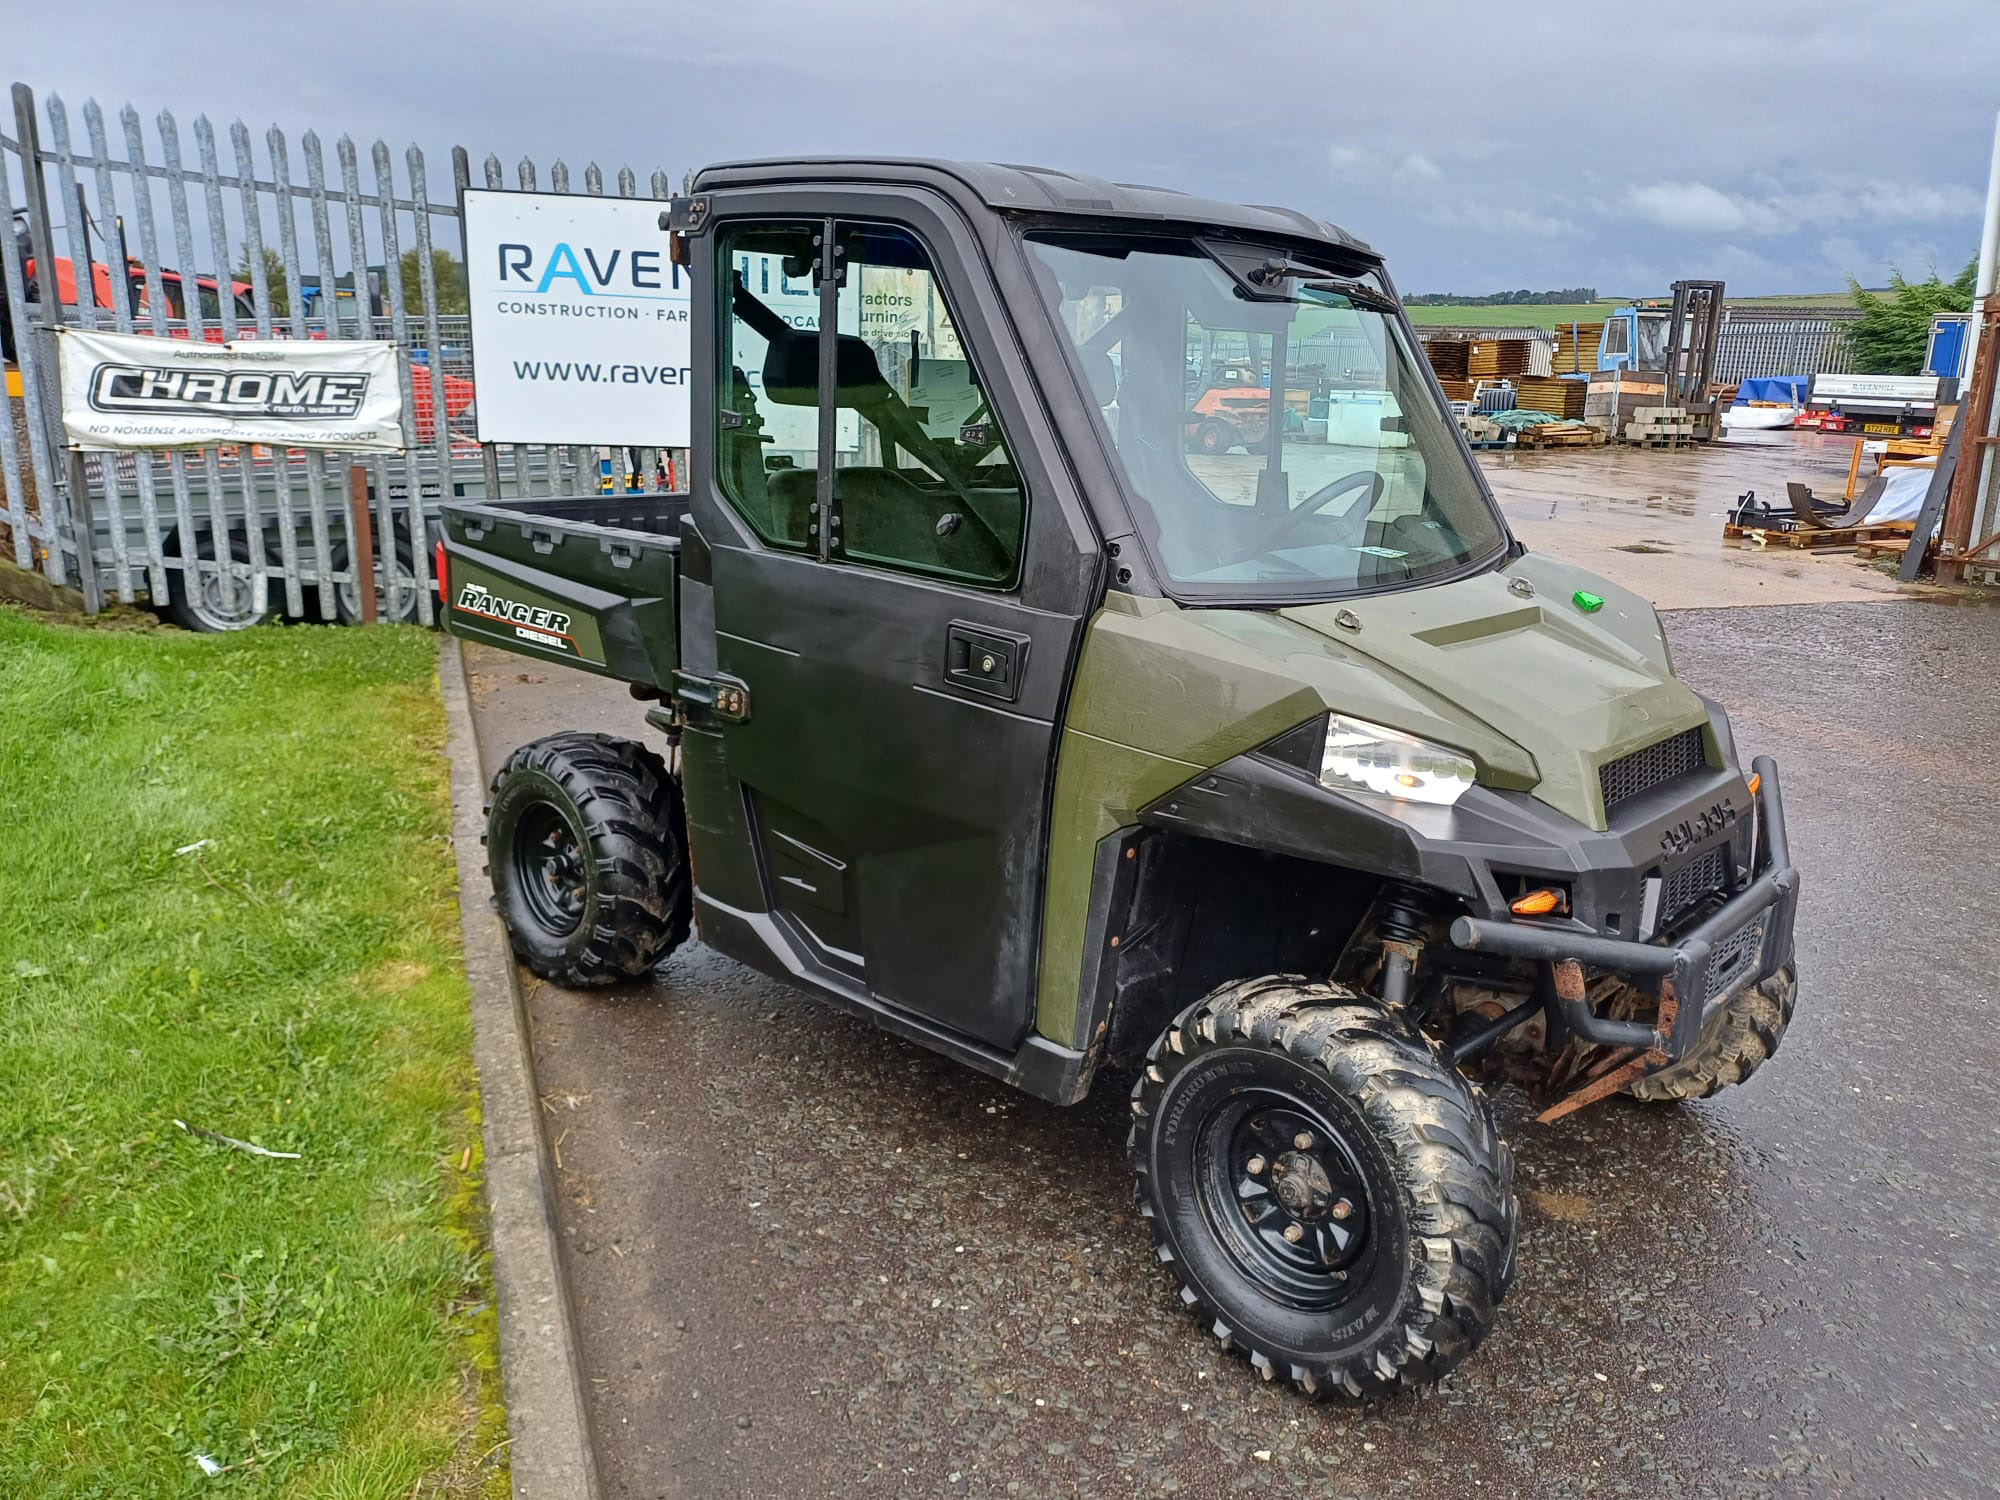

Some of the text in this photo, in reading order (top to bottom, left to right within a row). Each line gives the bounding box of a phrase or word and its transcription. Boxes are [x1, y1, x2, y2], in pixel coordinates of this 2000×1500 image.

[861, 293, 912, 306] actors
[497, 302, 688, 322] CONSTRUCTION FAR
[861, 310, 910, 325] urnin
[896, 330, 925, 340] sloy
[98, 365, 363, 407] CHROME
[273, 405, 305, 413] north
[88, 424, 110, 434] NO
[112, 425, 176, 435] NONSENSE
[177, 426, 252, 436] AUTOMOE
[319, 431, 378, 441] PRODUCTS
[458, 589, 571, 634] RANGER
[515, 626, 568, 649] DIESEL
[1164, 1061, 1256, 1147] FORERUNN
